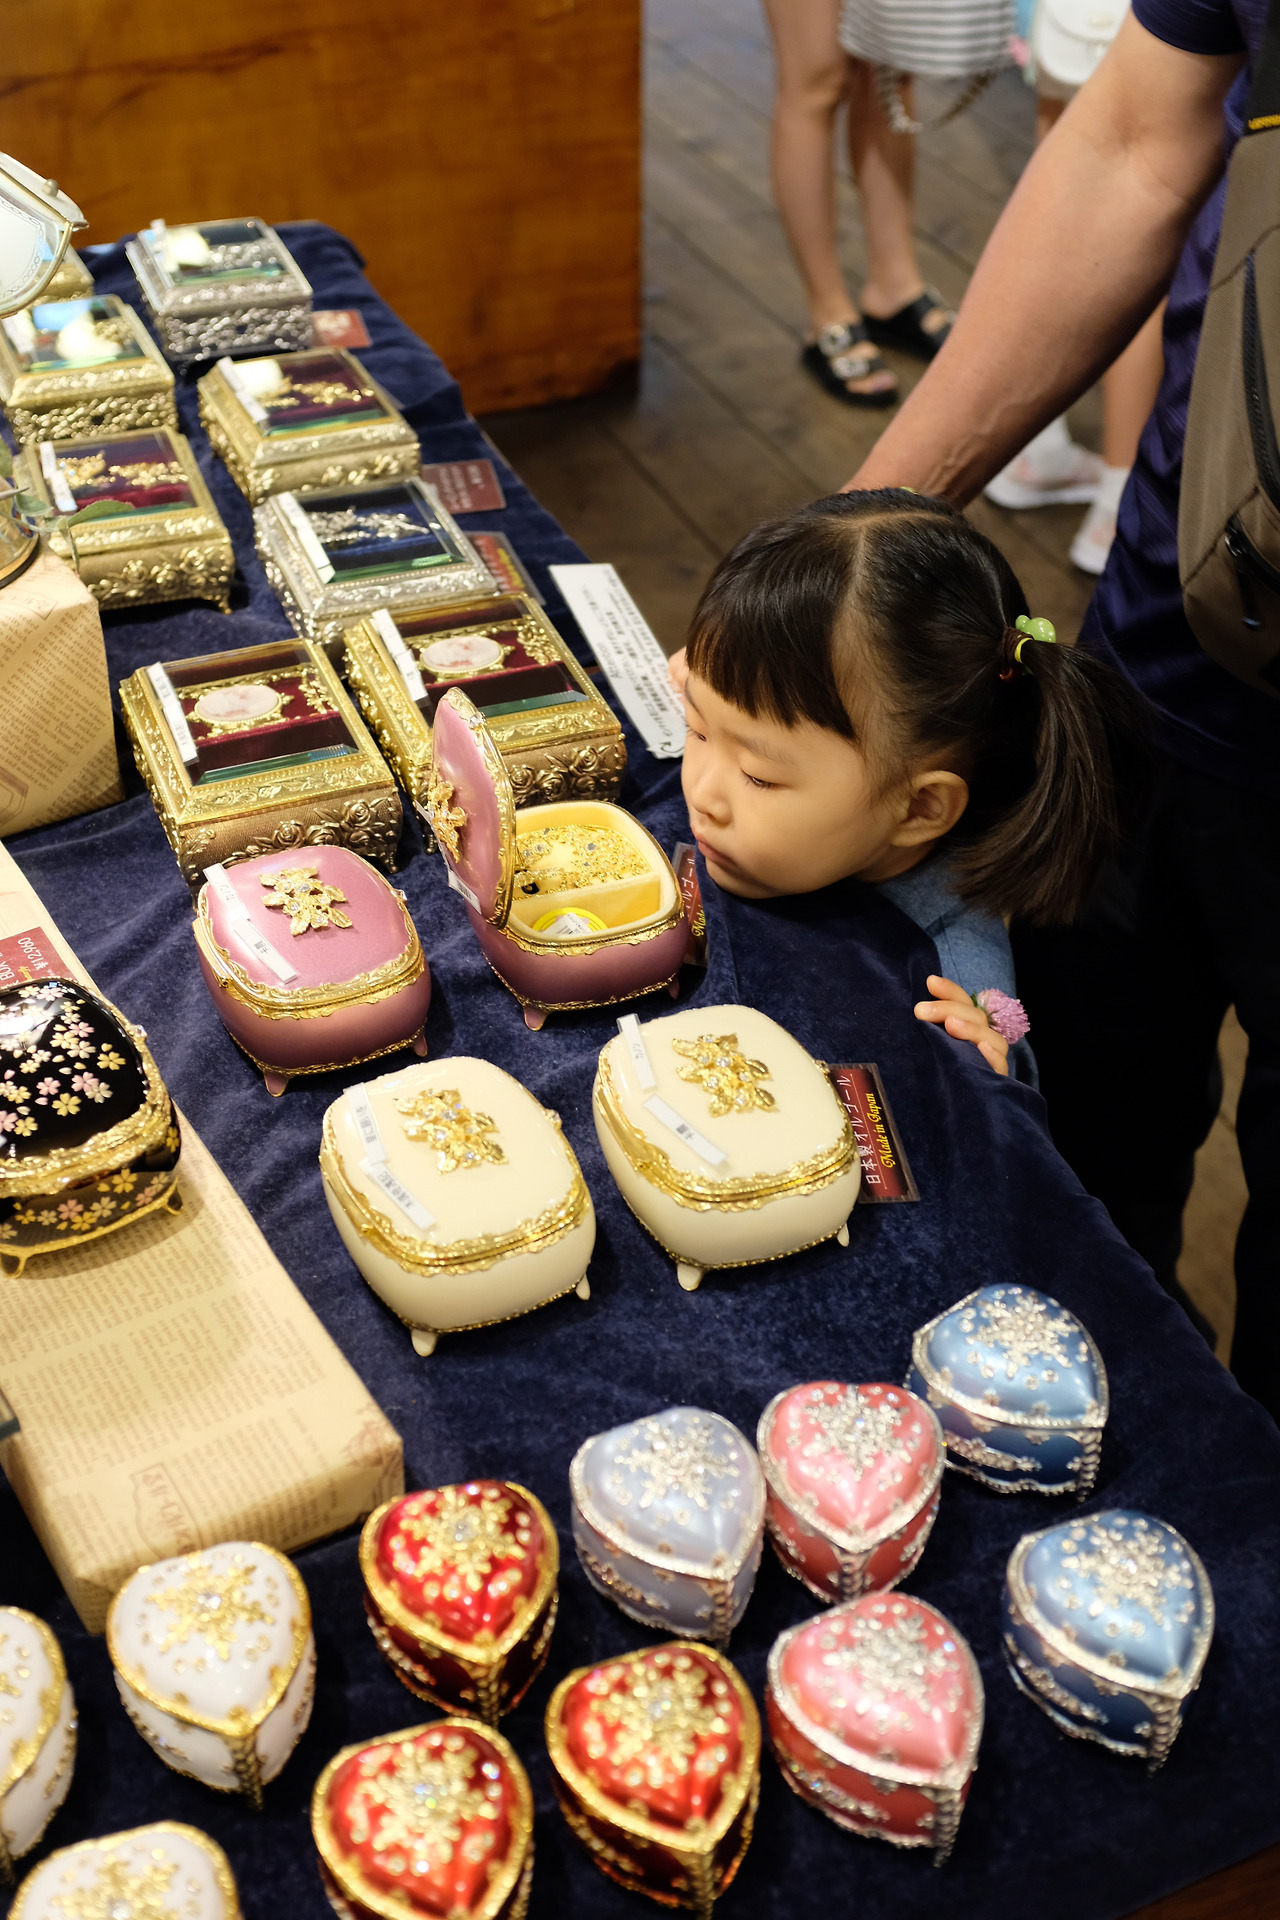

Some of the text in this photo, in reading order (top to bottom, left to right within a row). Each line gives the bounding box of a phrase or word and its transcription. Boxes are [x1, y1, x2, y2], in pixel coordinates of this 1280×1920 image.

[593, 640, 621, 682] Attention
[17, 937, 48, 971] ¥12,960
[865, 1092, 896, 1169] Made in Japan
